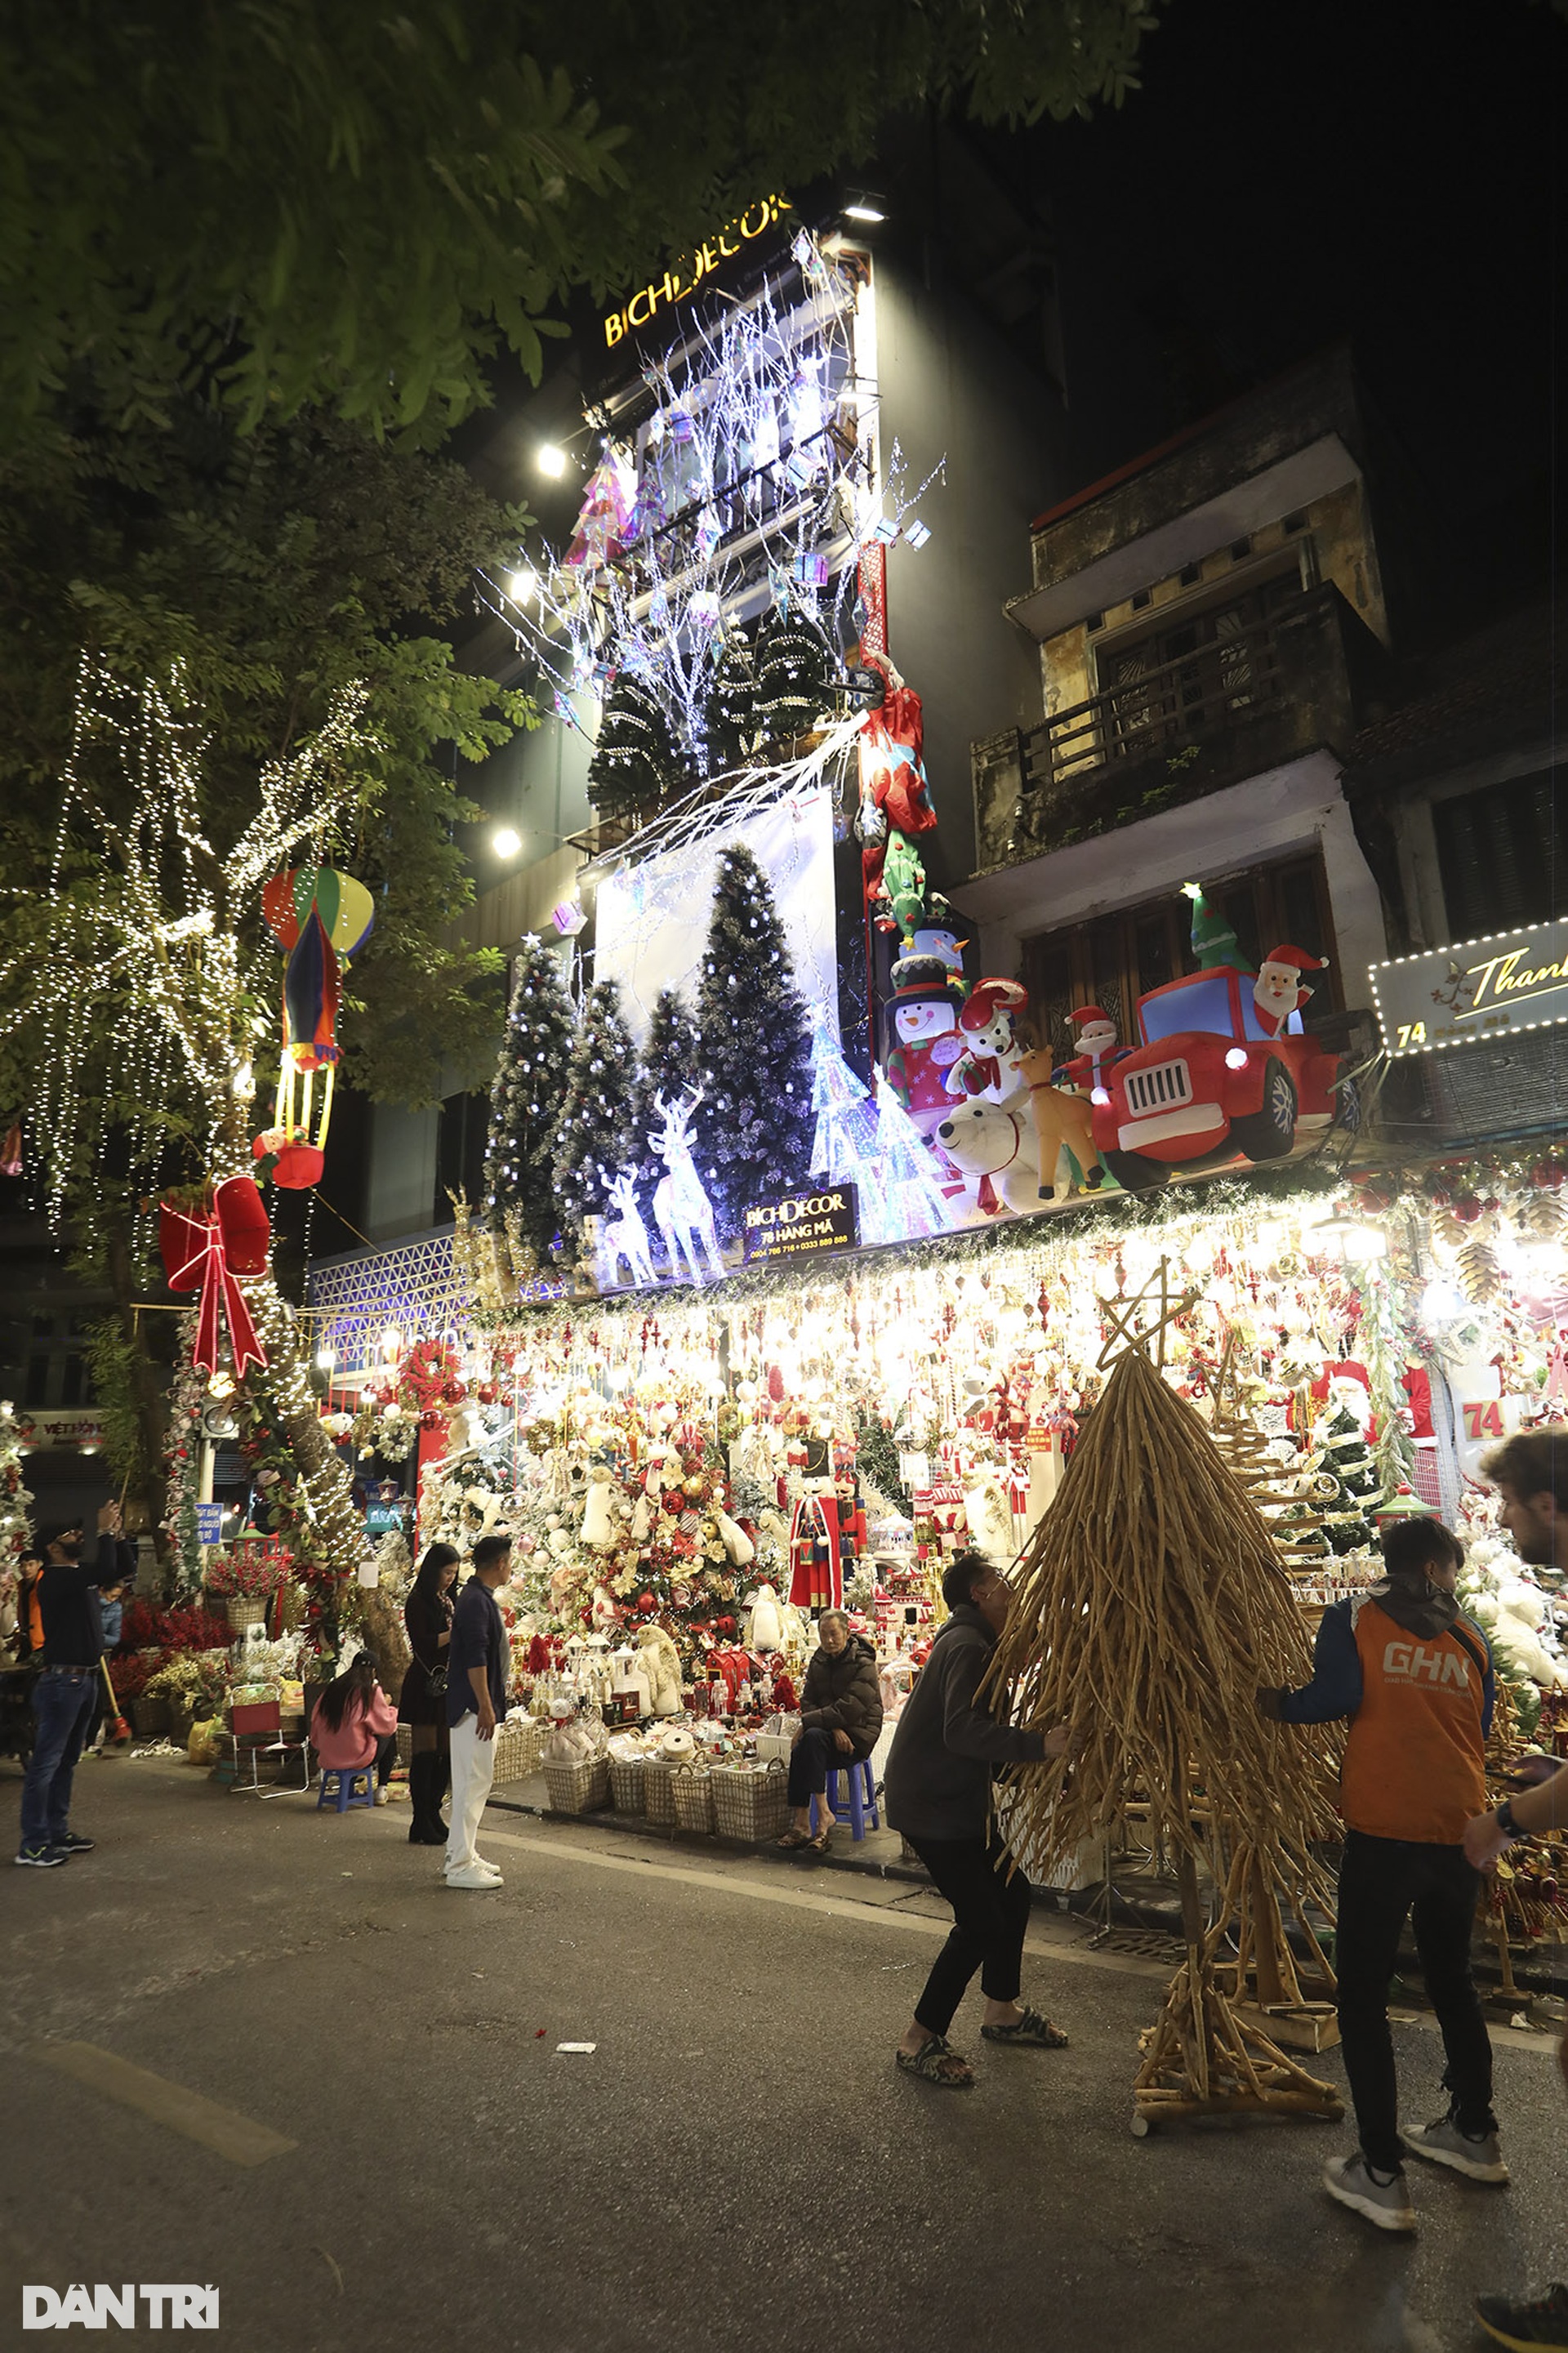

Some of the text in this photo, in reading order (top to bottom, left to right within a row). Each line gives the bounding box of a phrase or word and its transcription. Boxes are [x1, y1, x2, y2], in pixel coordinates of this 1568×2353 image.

[1396, 1021, 1427, 1048] 74
[776, 1223, 812, 1242] HÀNG
[814, 1218, 834, 1235] MÃ
[800, 1241, 818, 1250] 0333
[1463, 1401, 1503, 1437] 74
[1383, 1641, 1470, 1687] GHN
